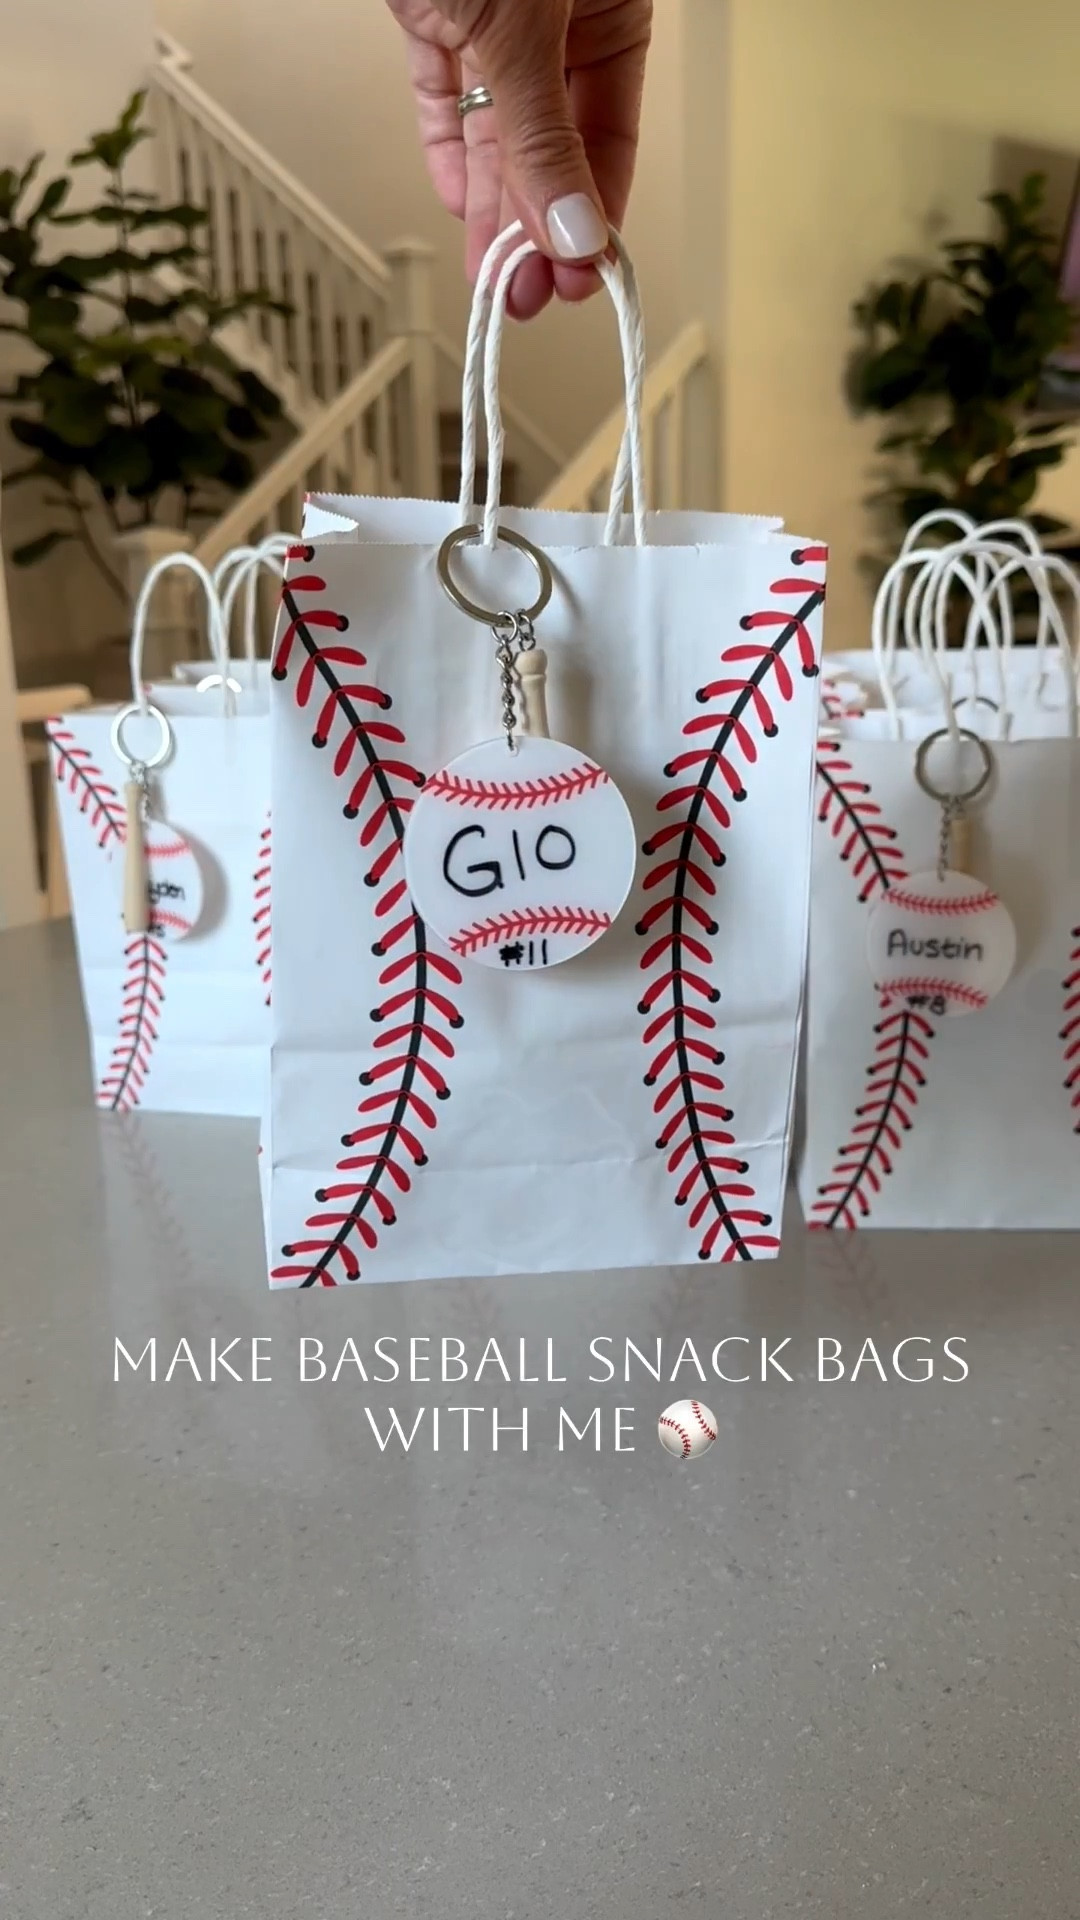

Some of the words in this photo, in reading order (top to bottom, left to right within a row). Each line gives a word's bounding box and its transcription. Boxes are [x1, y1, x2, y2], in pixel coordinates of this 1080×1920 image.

[442, 824, 576, 897] GIO
[499, 938, 547, 967] #11
[886, 928, 984, 962] Austin
[905, 994, 947, 1016] #8
